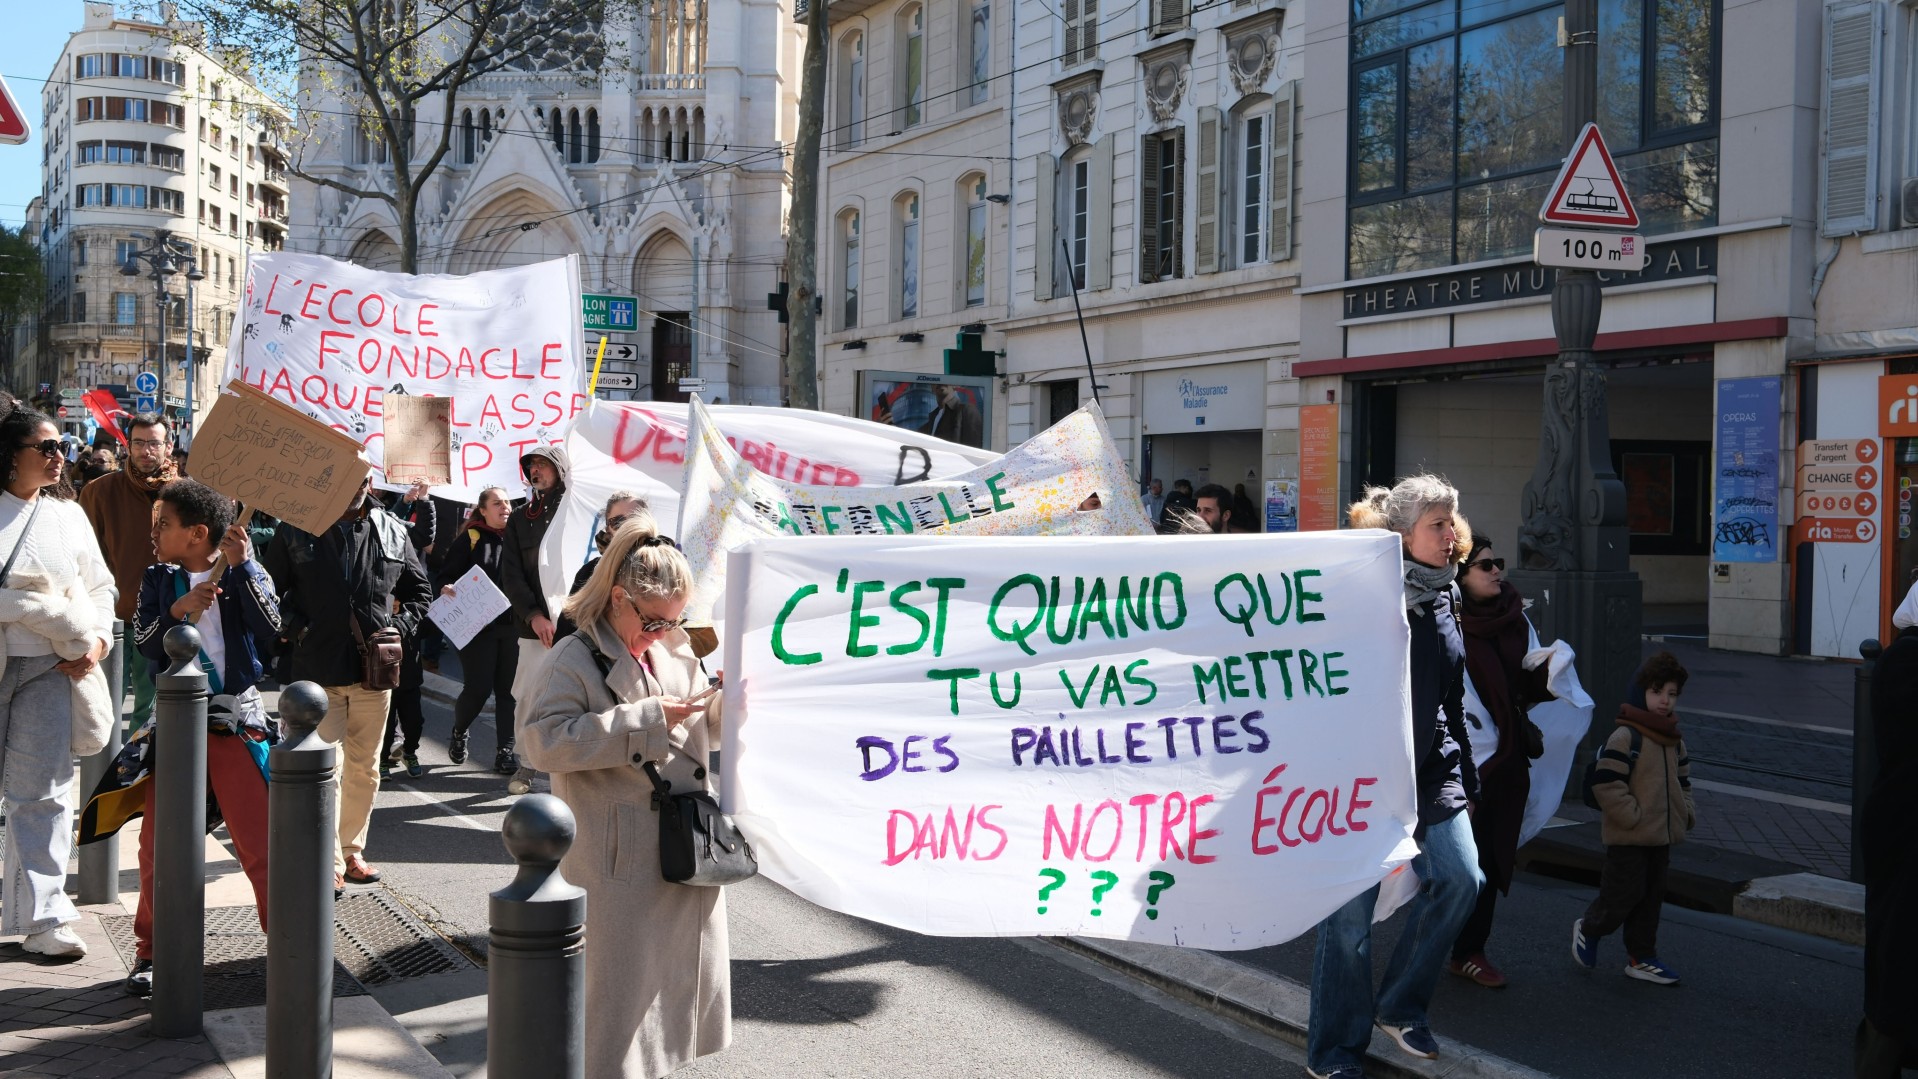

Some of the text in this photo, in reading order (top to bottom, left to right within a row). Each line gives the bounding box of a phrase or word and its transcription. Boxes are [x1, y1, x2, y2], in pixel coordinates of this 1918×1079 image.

[1563, 238, 1621, 261] 100 m
[1346, 276, 1482, 315] THEATRE
[319, 330, 562, 381] FONDACLE
[236, 364, 587, 431] HAQUE LASSE
[1183, 397, 1208, 409] Maladie
[1193, 384, 1228, 397] l'Assurance
[1889, 385, 1918, 424] ri
[213, 437, 250, 467] UN
[1814, 443, 1849, 451] Transfert
[1814, 453, 1847, 463] d'argent
[1808, 473, 1853, 484] CHANGE
[1808, 521, 1832, 539] ria
[771, 567, 1325, 666] C'EST QUAND QUE
[925, 648, 1351, 716] TU VAS METTRE
[855, 733, 960, 782] DES
[880, 762, 1379, 867] DANS NOTRE ÉCOLE
